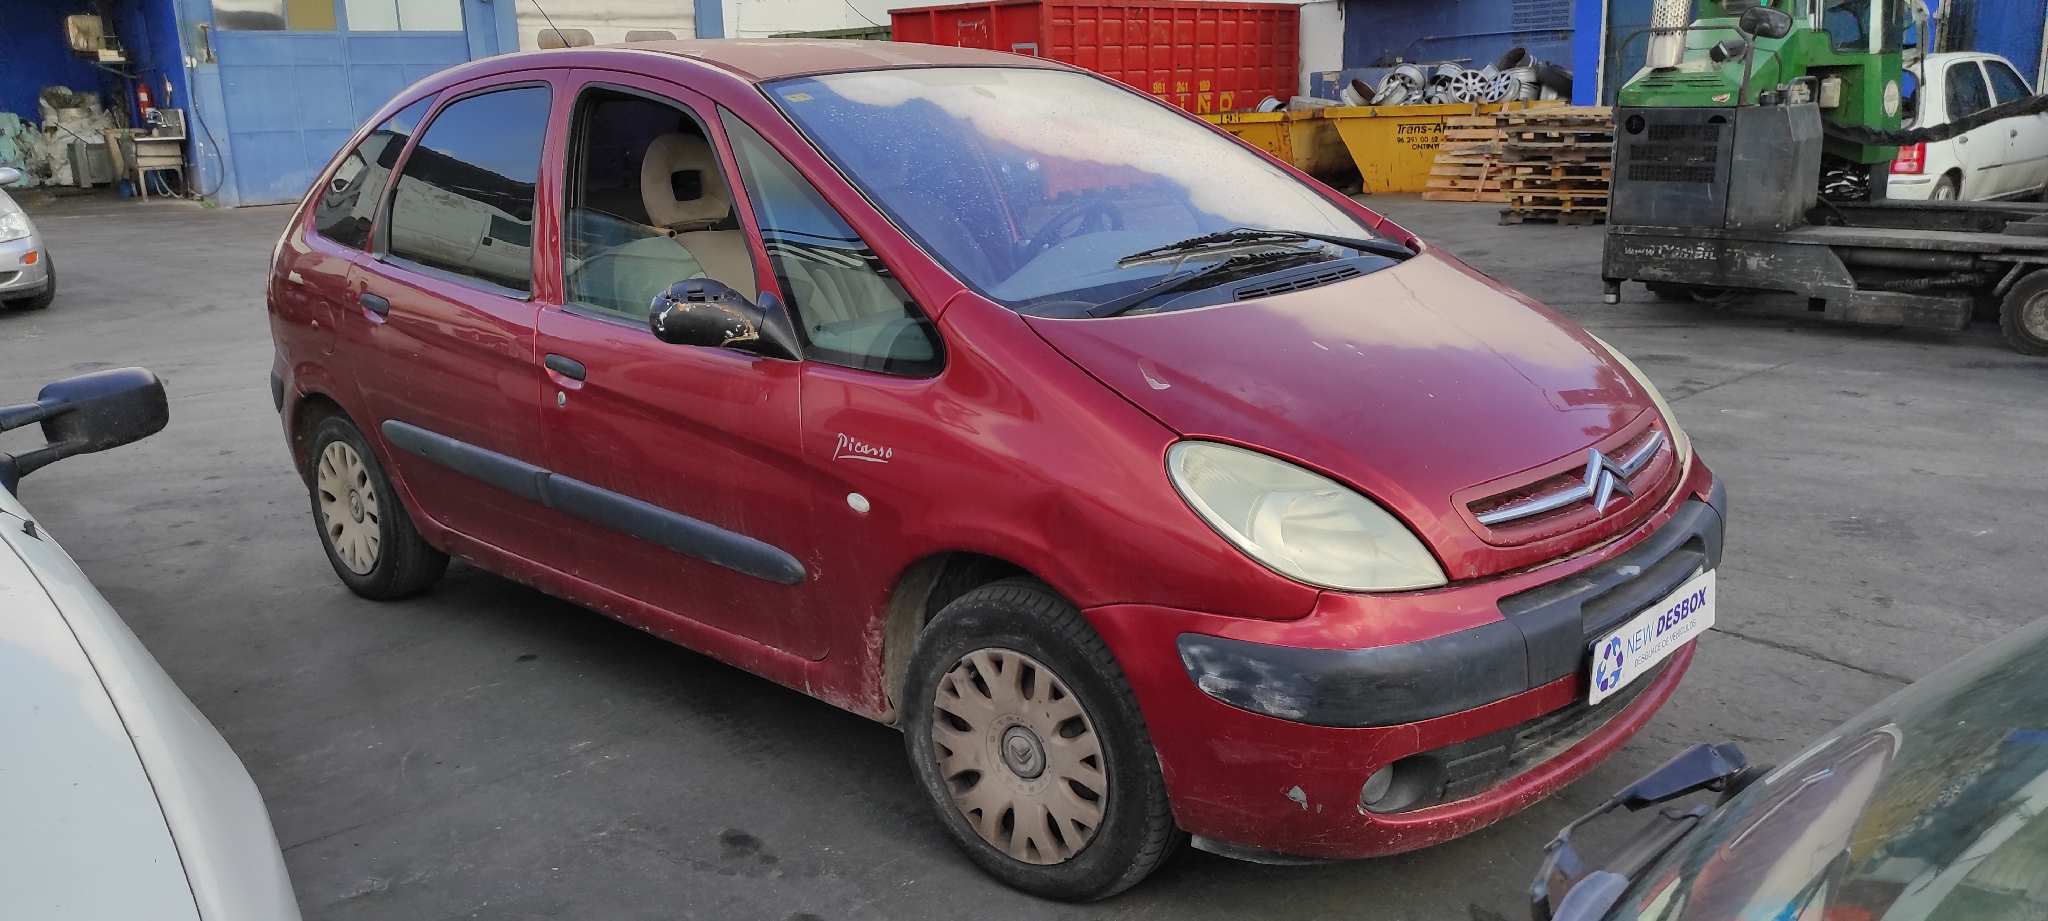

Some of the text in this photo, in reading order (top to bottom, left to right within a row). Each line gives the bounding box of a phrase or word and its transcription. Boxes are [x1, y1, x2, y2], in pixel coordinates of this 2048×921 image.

[832, 432, 893, 462] Picasso
[1626, 585, 1707, 657] NEW DESBOX
